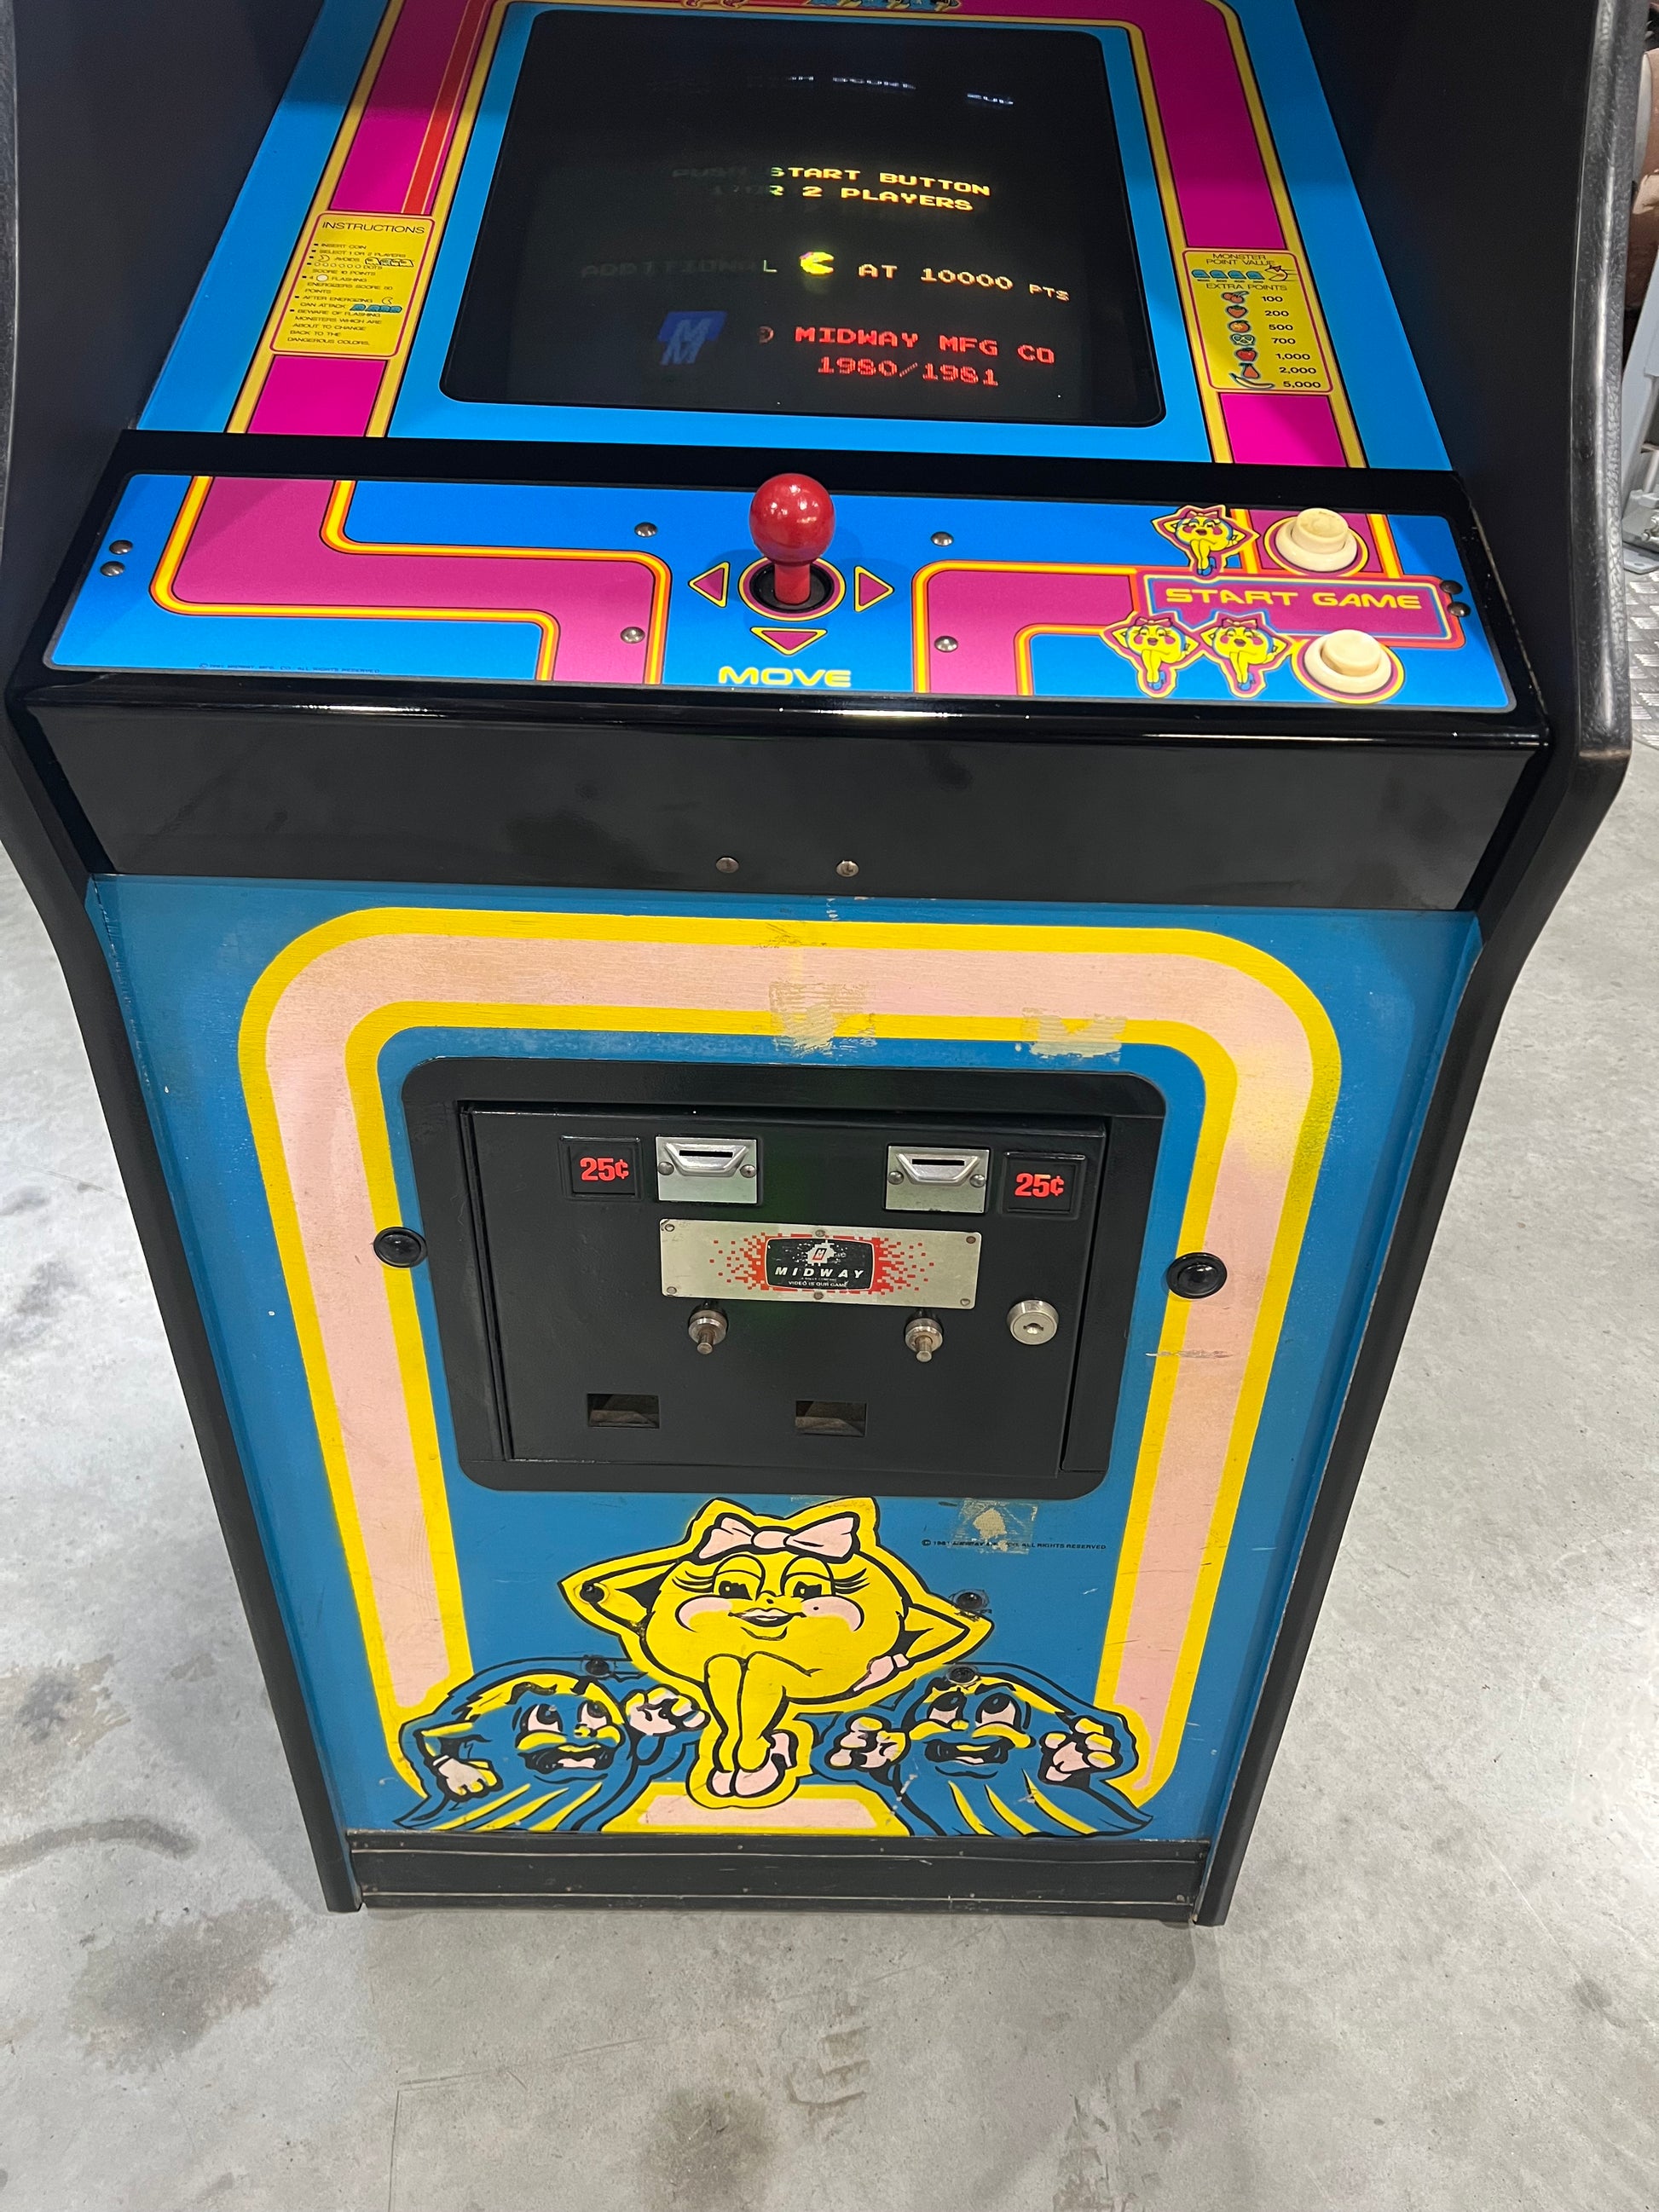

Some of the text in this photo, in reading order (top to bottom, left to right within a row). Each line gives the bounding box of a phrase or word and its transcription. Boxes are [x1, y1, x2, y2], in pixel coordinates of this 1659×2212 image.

[771, 167, 860, 181] START
[879, 172, 991, 197] BUTTON
[802, 186, 823, 198] 2
[841, 187, 974, 211] PLAYERS
[321, 222, 425, 234] INSTRUCTIONS
[858, 263, 898, 279] AT
[920, 268, 1014, 290] 10000
[1028, 283, 1070, 302] PTS
[795, 326, 919, 349] MIDWAY
[939, 335, 998, 356] MFG
[1017, 344, 1055, 365] CO
[818, 356, 999, 387] 1980/1981
[1283, 380, 1321, 389] 5,000
[1165, 587, 1423, 610] START GAME
[719, 666, 853, 688] MOVE
[580, 1157, 629, 1181] 25¢
[1014, 1172, 1065, 1198] 25¢
[774, 1267, 864, 1279] MIDWAY
